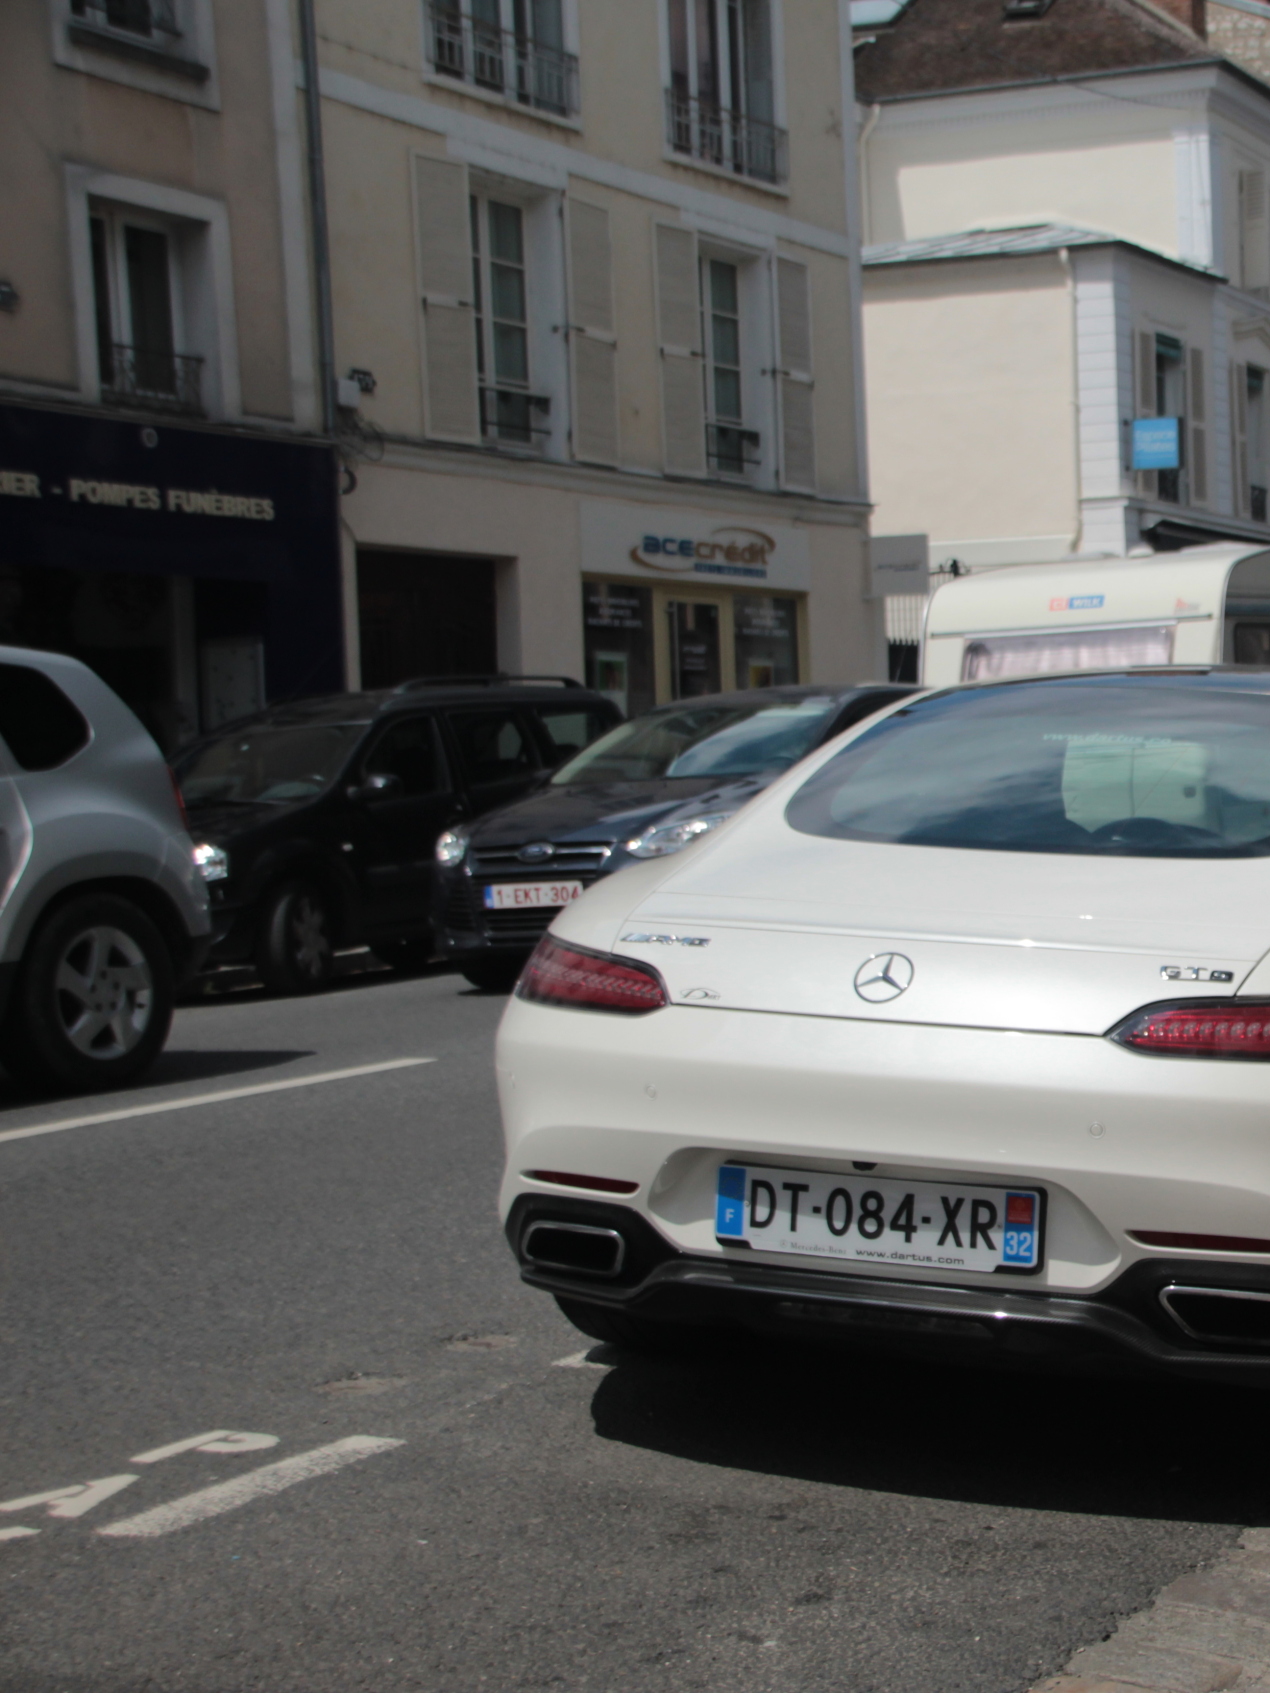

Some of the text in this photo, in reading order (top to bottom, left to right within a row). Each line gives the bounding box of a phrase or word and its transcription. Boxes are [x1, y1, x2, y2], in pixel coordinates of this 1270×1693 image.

[69, 478, 160, 509] POMPES
[167, 487, 275, 521] FUNÈBRES
[725, 1208, 735, 1223] F
[750, 1179, 998, 1251] DT-084-XR
[790, 1241, 847, 1255] Mercedes-Benz
[1005, 1231, 1032, 1257] 32
[856, 1249, 965, 1265] www.dartus.com
